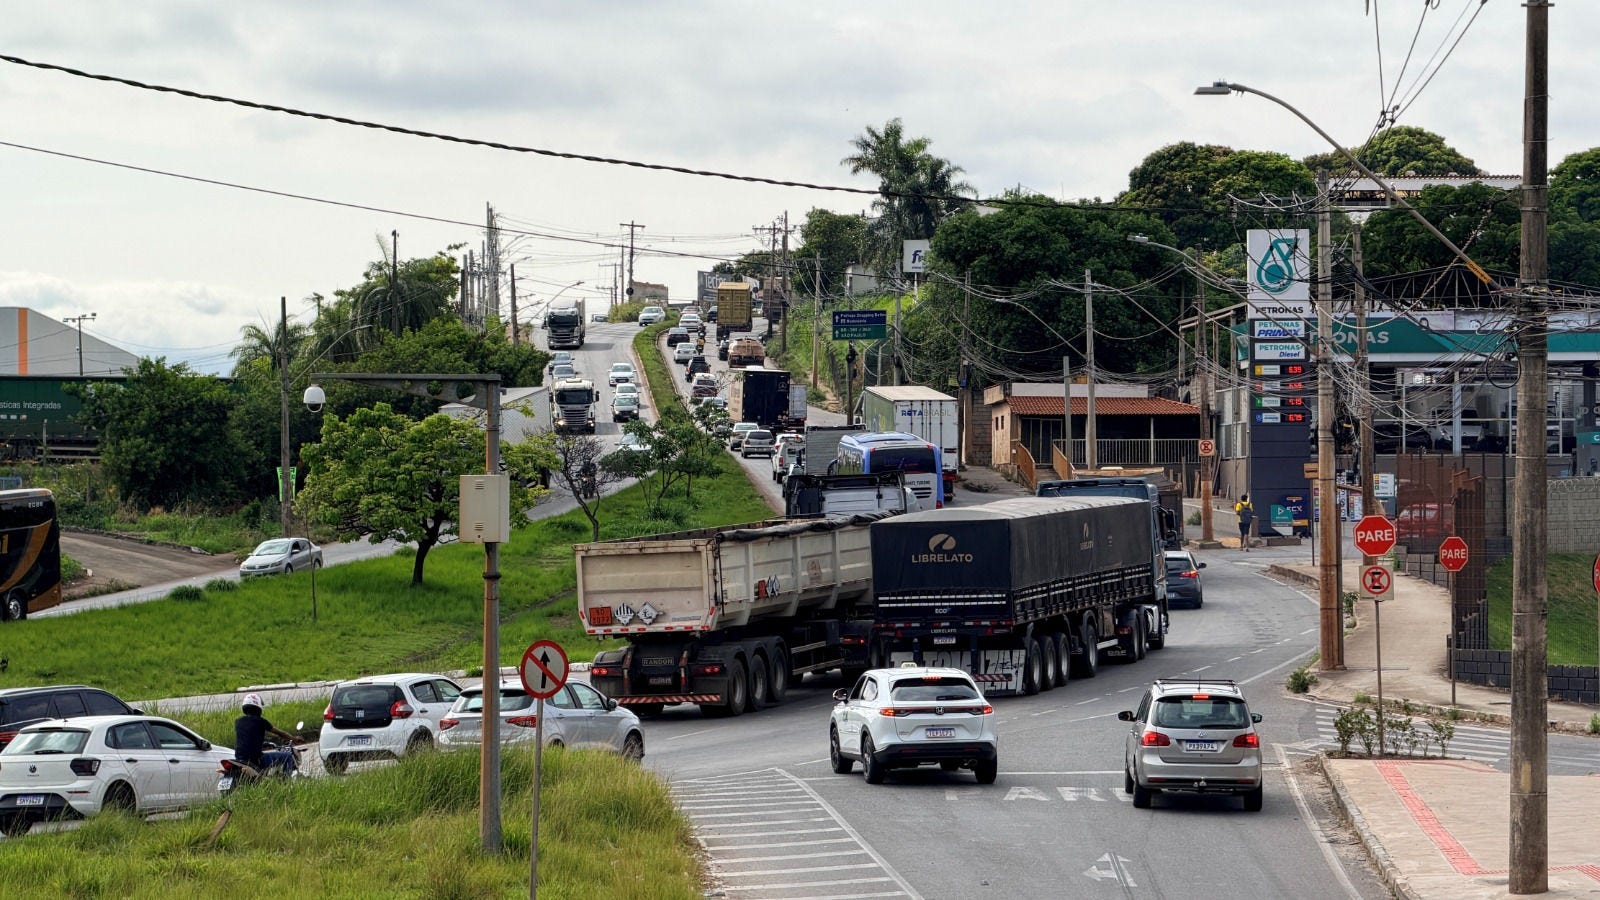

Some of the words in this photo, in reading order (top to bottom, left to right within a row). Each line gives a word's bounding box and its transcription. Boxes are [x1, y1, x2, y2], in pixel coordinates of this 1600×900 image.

[0, 401, 21, 409] sticas
[1357, 529, 1393, 542] PARE
[911, 553, 974, 564] LIBRELATO
[1441, 549, 1466, 559] PARE
